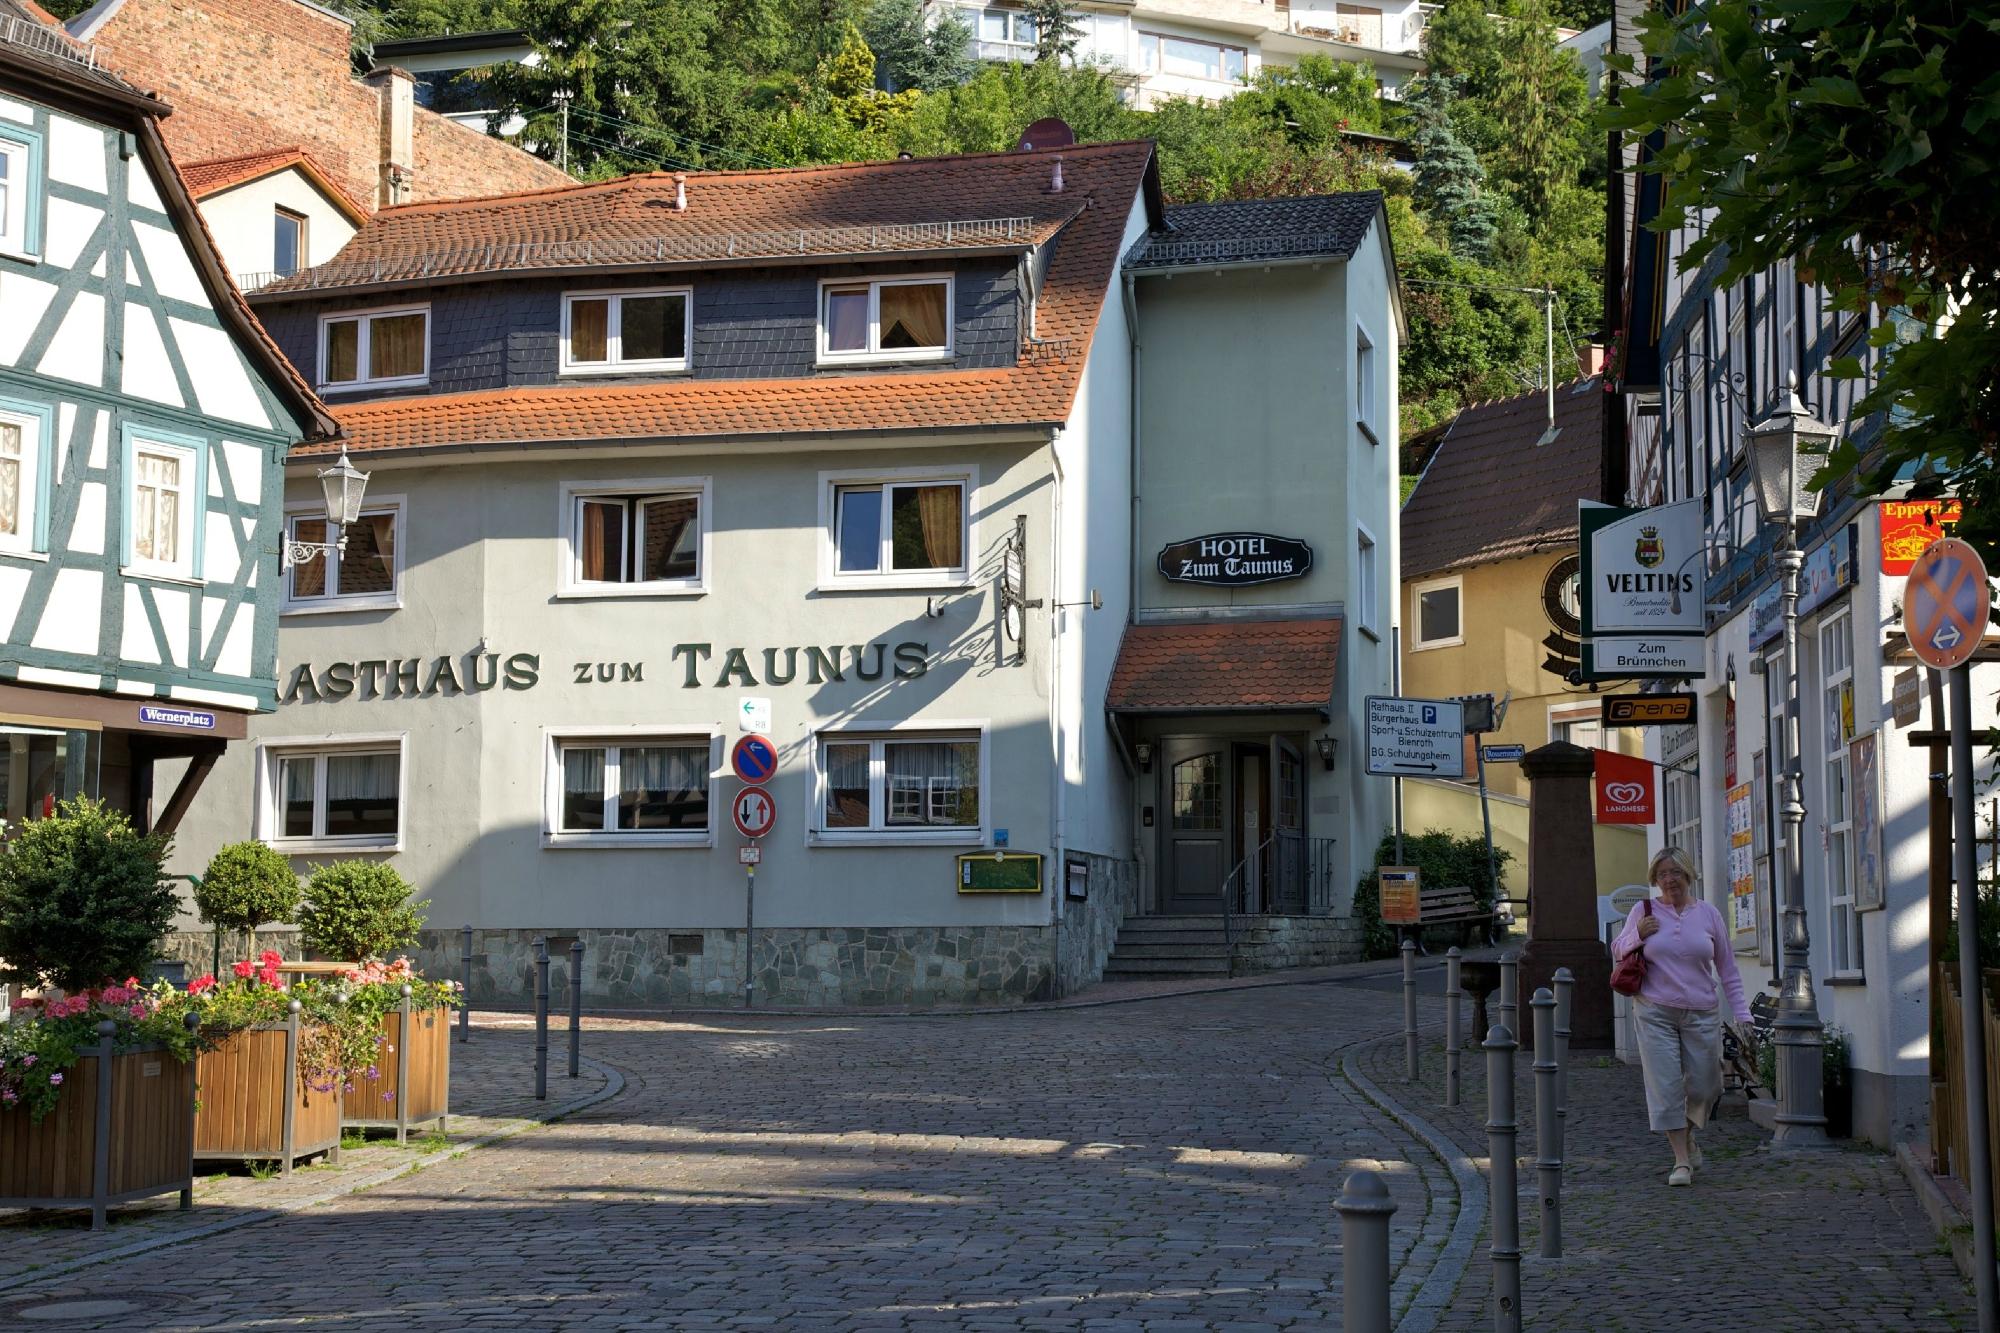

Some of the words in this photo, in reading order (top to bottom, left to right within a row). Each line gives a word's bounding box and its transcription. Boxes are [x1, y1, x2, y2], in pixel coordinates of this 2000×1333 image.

[1200, 538, 1270, 558] HOTEL
[1180, 559, 1220, 578] Zum
[1224, 557, 1294, 577] Taunus
[1606, 573, 1694, 593] VELTINS
[1638, 643, 1666, 654] Zum
[1617, 655, 1686, 667] Brünnchen
[275, 653, 541, 700] ASTHAUS
[573, 661, 644, 684] ZUM
[672, 642, 929, 689] TAUNUS
[1371, 702, 1405, 713] Rathaus
[1617, 703, 1688, 716] arena
[145, 708, 210, 726] Wernerplatz
[1371, 713, 1419, 725] Bürgerhaus
[1425, 707, 1434, 722] P
[1398, 737, 1434, 748] Bienroth
[1387, 748, 1451, 761] Schulungsheim
[1605, 804, 1647, 813] LANGNESE
